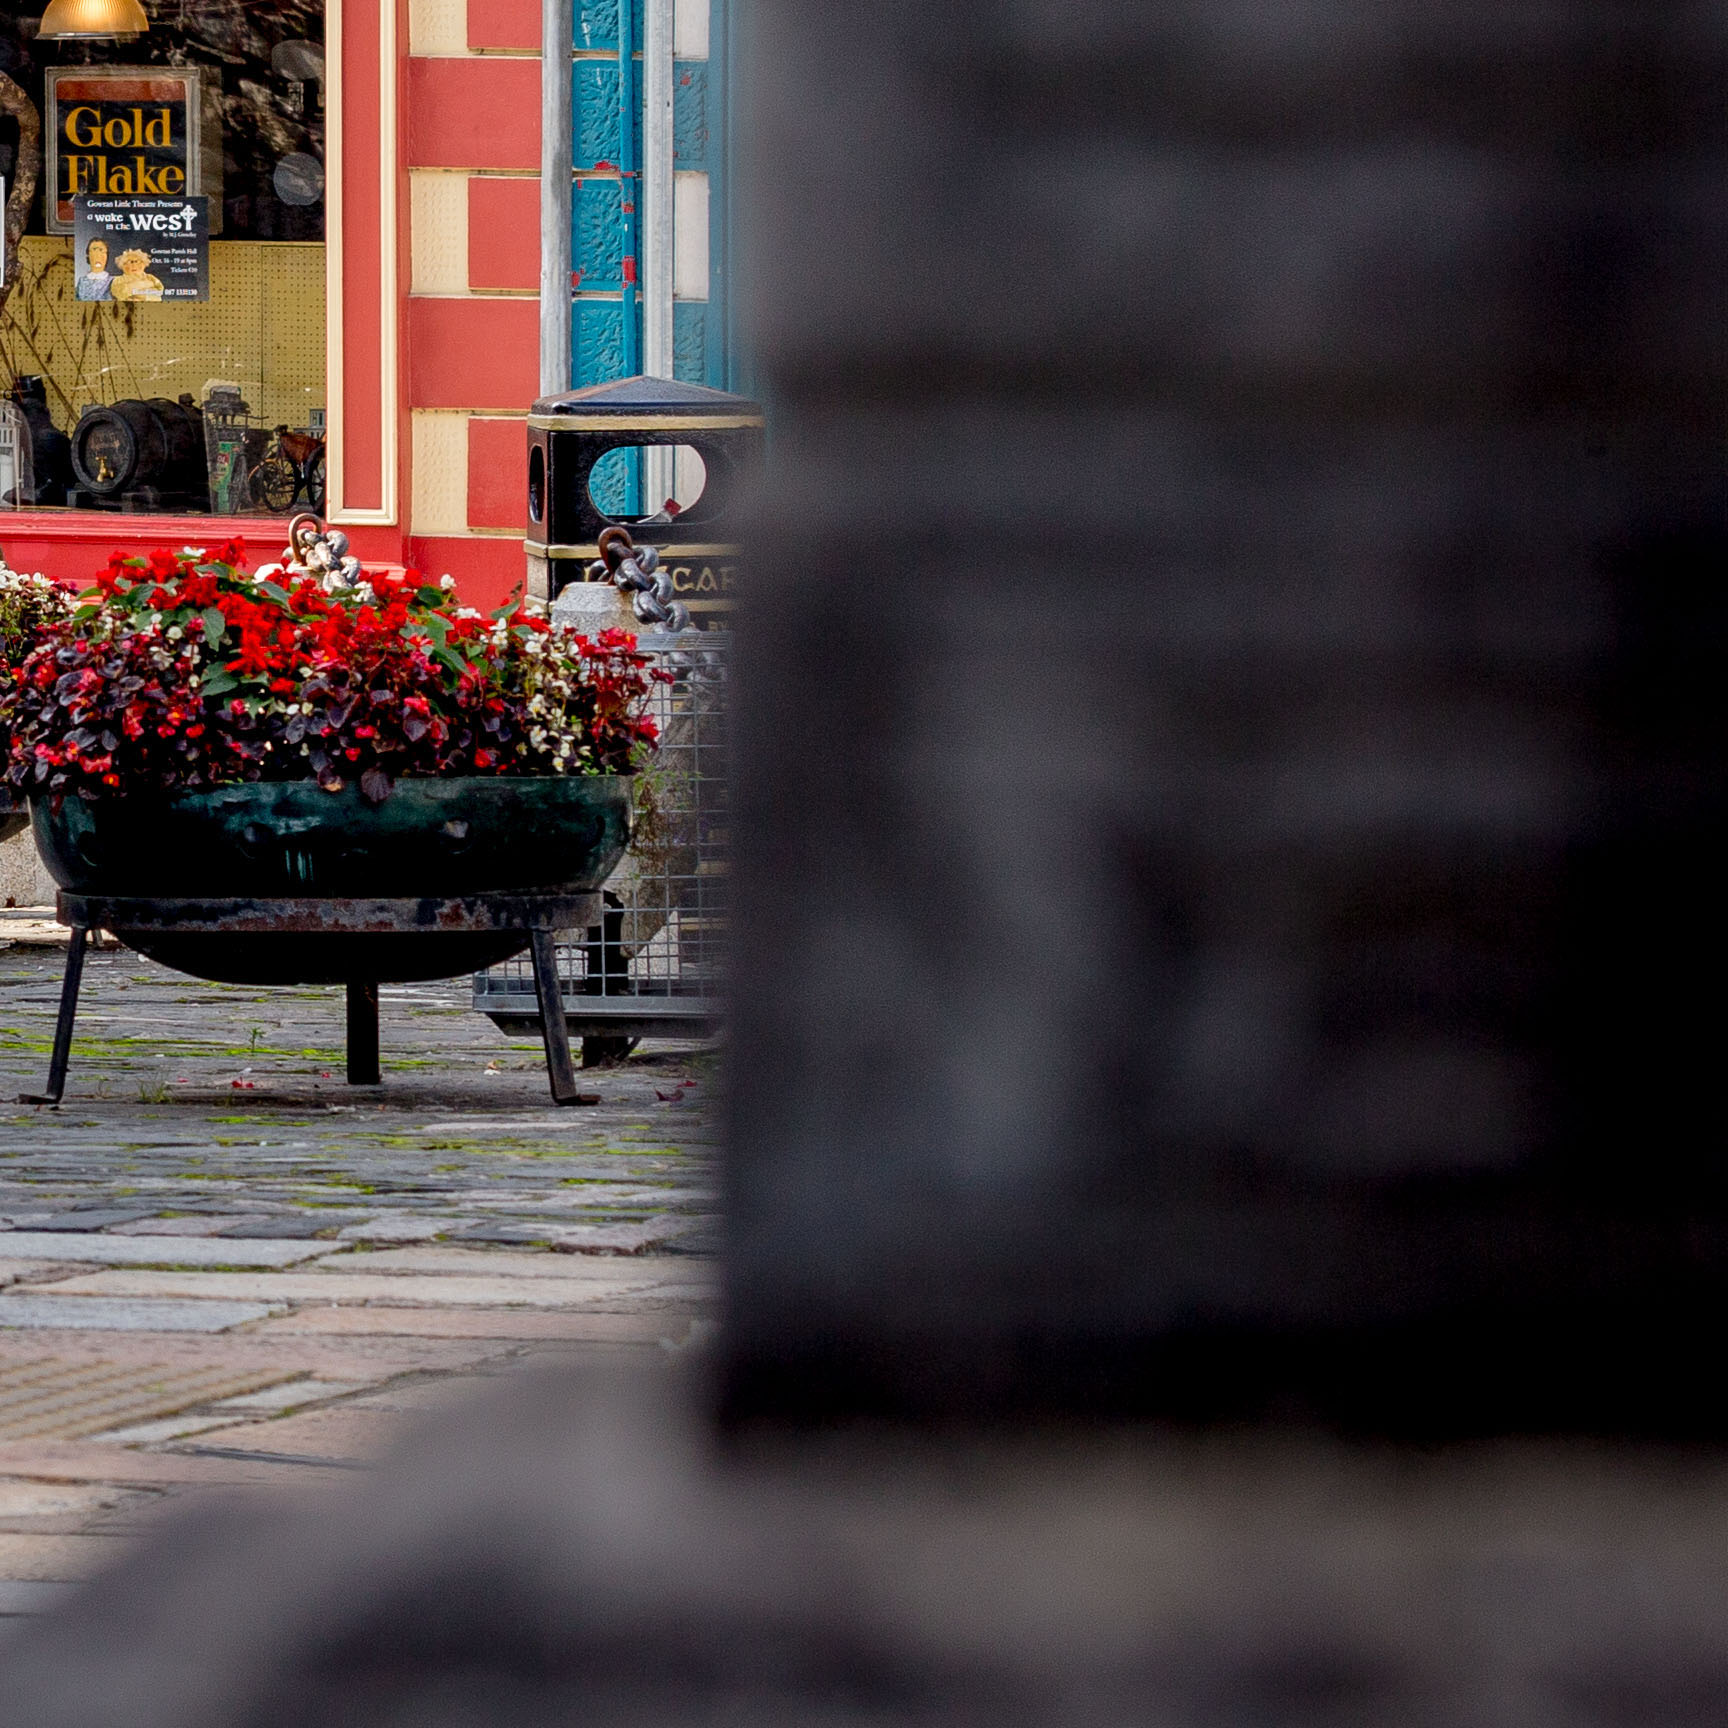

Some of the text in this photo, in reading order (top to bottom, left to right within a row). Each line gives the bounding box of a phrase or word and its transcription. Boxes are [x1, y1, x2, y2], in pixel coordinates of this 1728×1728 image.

[65, 106, 177, 148] Gold
[60, 155, 185, 195] Flake
[114, 200, 131, 208] Little
[132, 200, 156, 208] Theatre
[157, 200, 184, 208] Presents
[94, 213, 124, 222] wake
[129, 205, 198, 231] west
